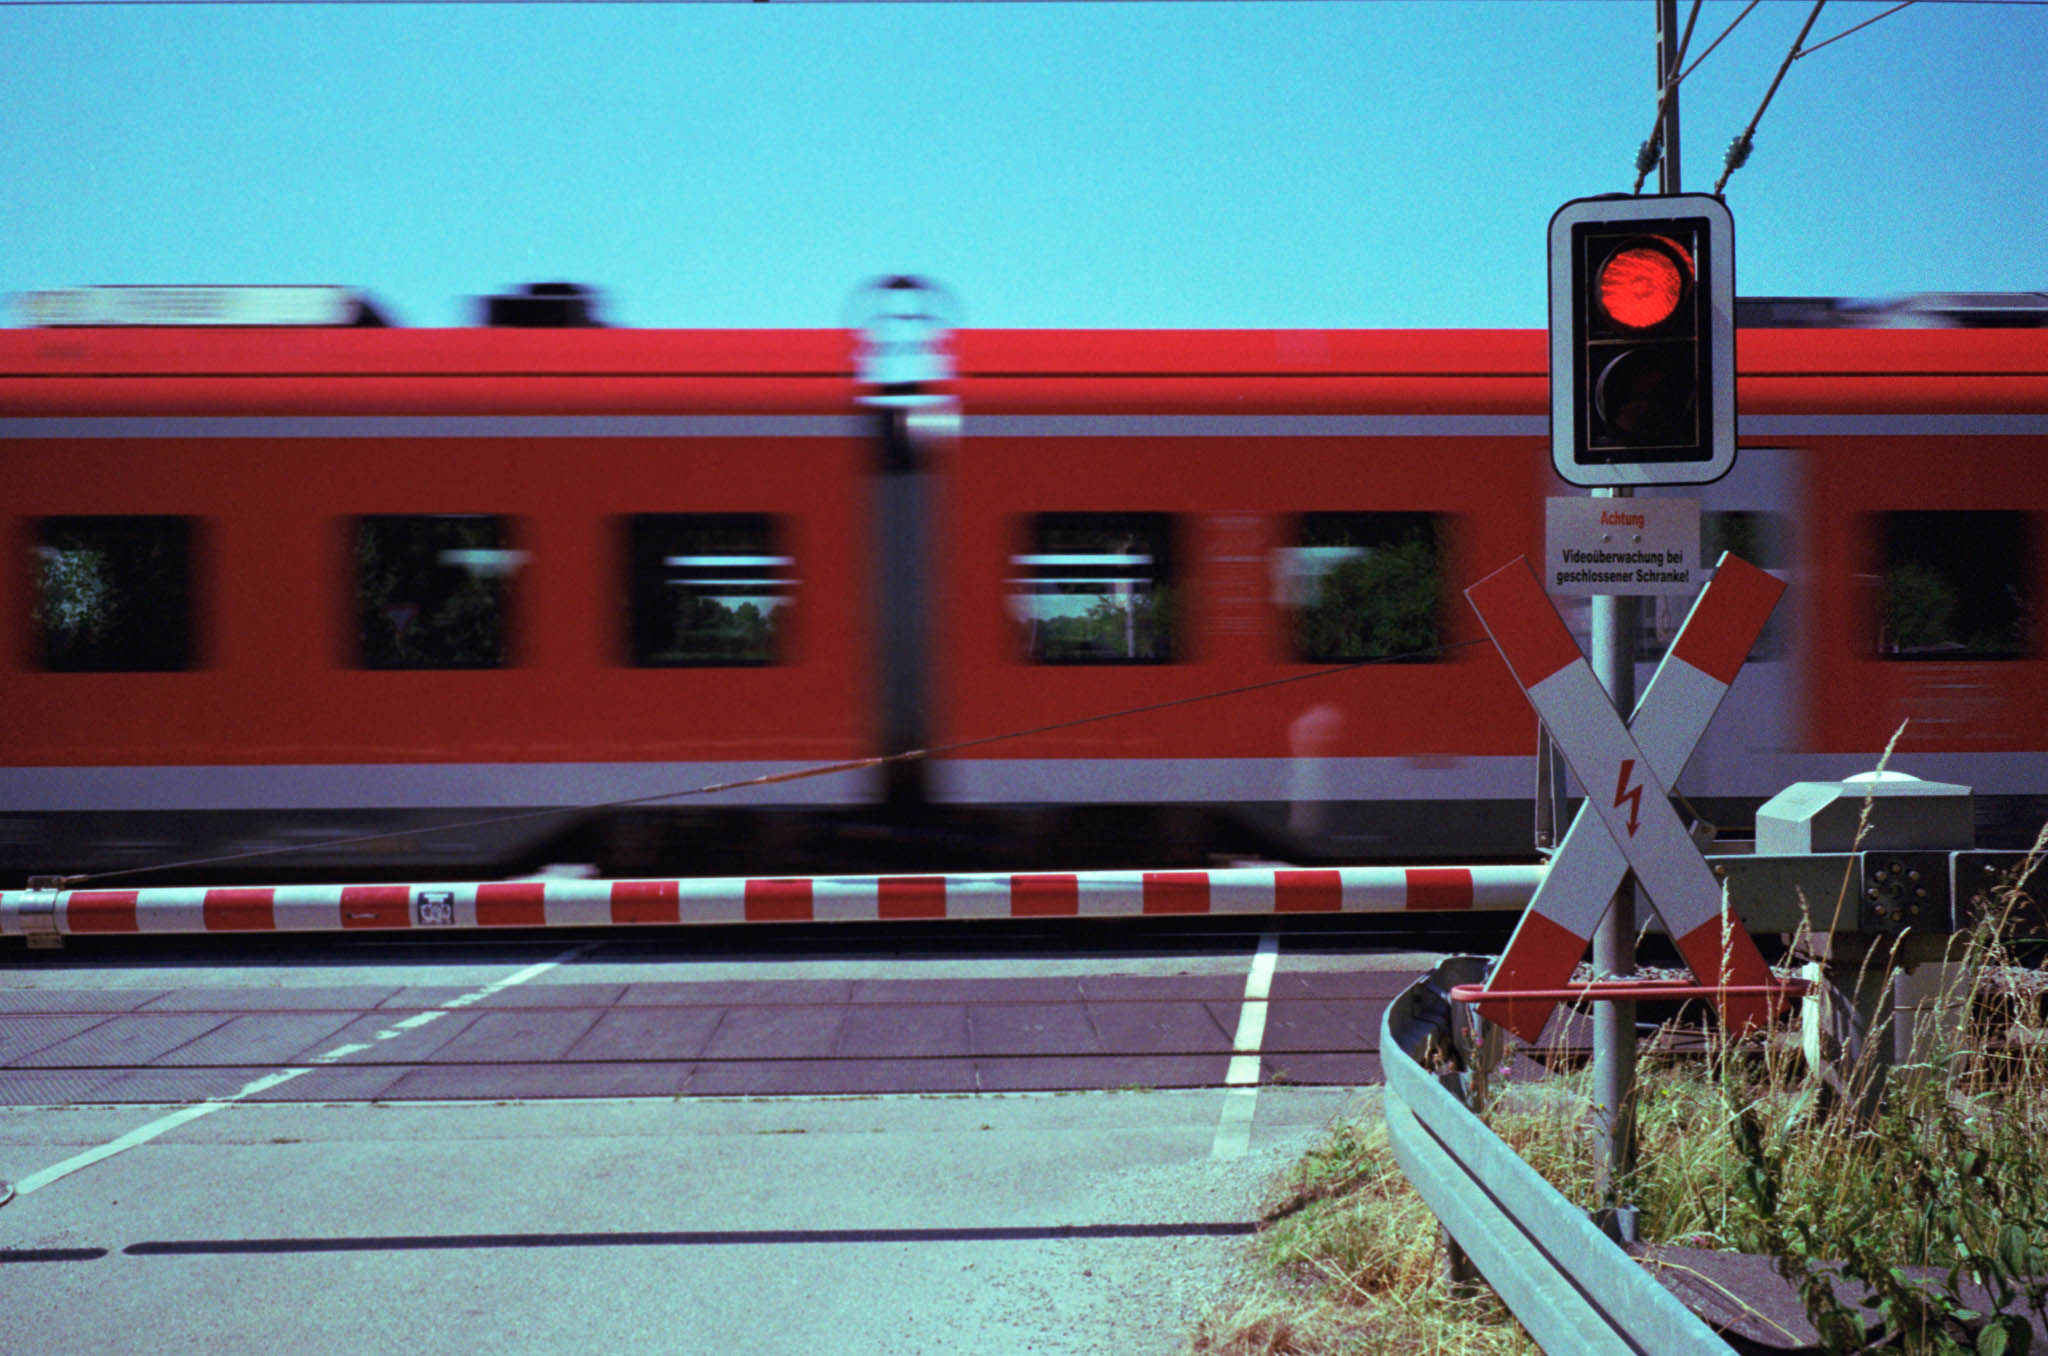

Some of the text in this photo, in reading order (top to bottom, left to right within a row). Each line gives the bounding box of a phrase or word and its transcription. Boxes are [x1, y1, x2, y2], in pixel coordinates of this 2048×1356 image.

[1600, 511, 1645, 529] Achtung
[1562, 549, 1683, 567] Videoüberwachung bei
[1556, 569, 1689, 585] geschlossener Schranke!
